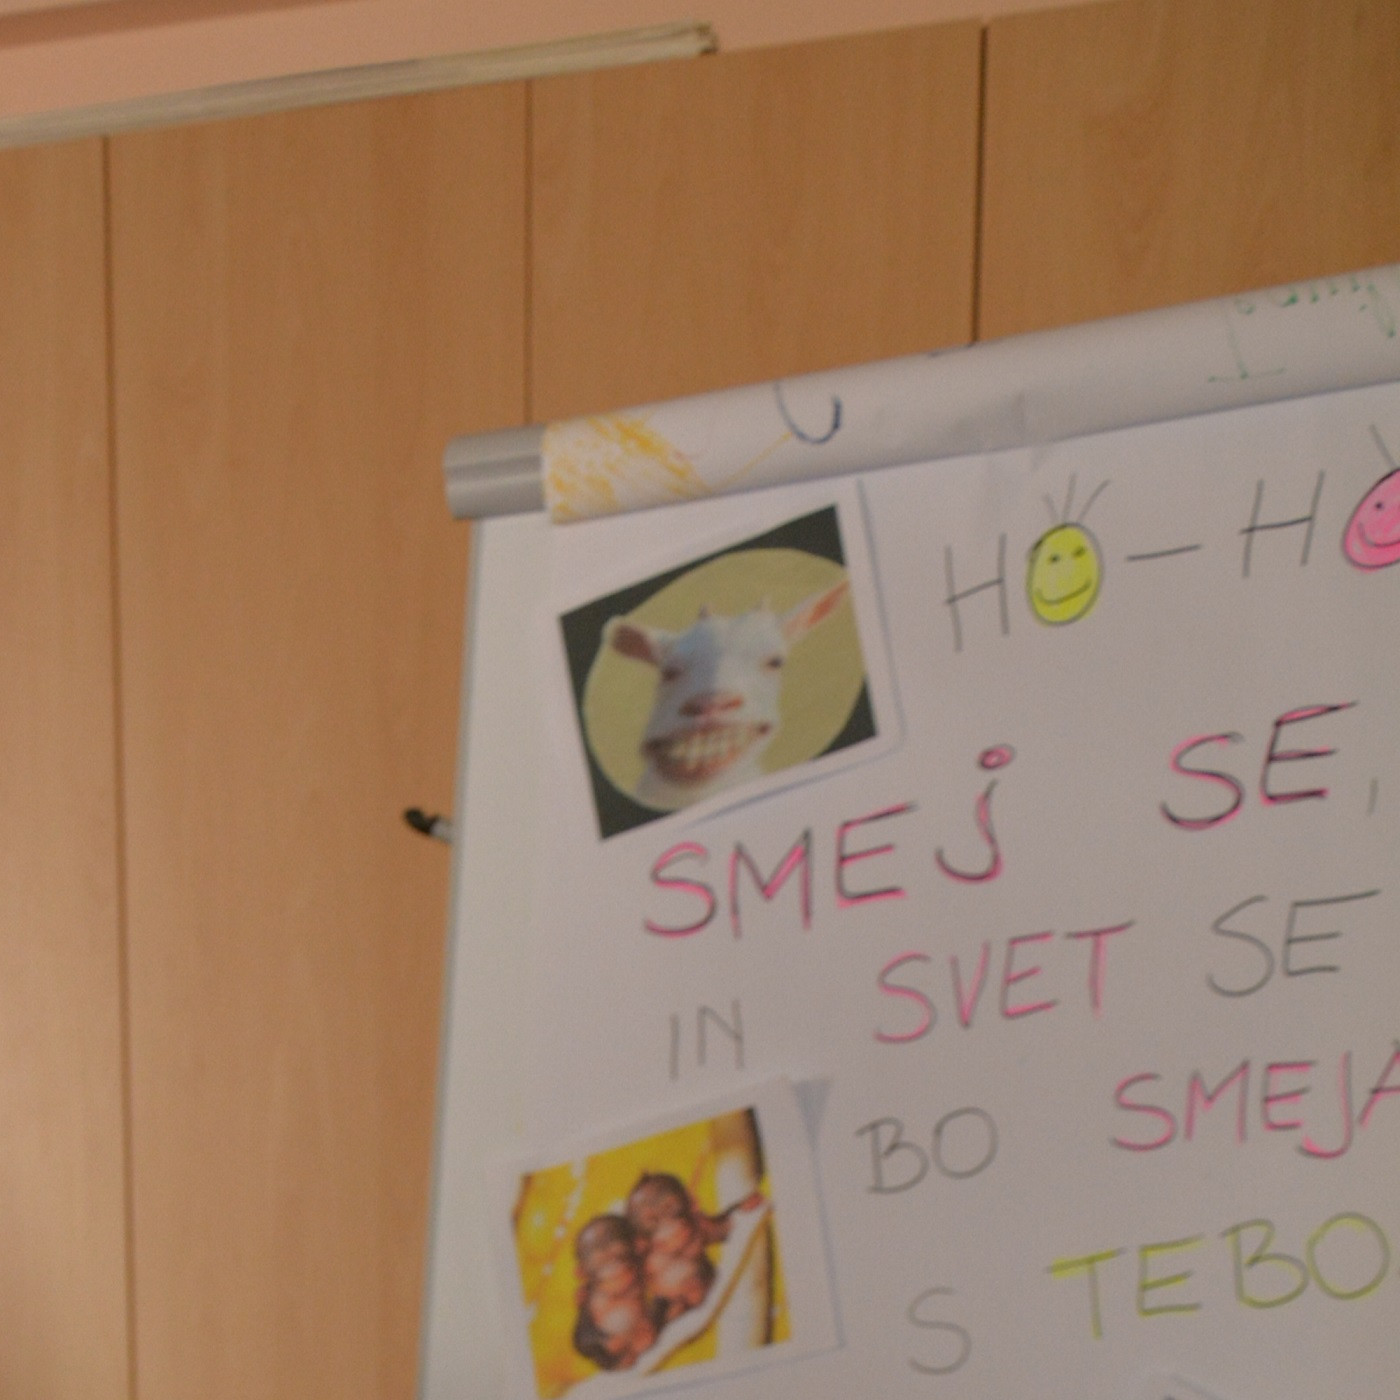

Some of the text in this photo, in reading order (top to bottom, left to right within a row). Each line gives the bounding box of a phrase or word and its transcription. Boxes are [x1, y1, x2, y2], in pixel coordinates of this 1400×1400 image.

[668, 889, 1381, 1081] IN SVET SE
[855, 1106, 998, 1194] BO
[906, 1211, 1400, 1375] S TEBO
